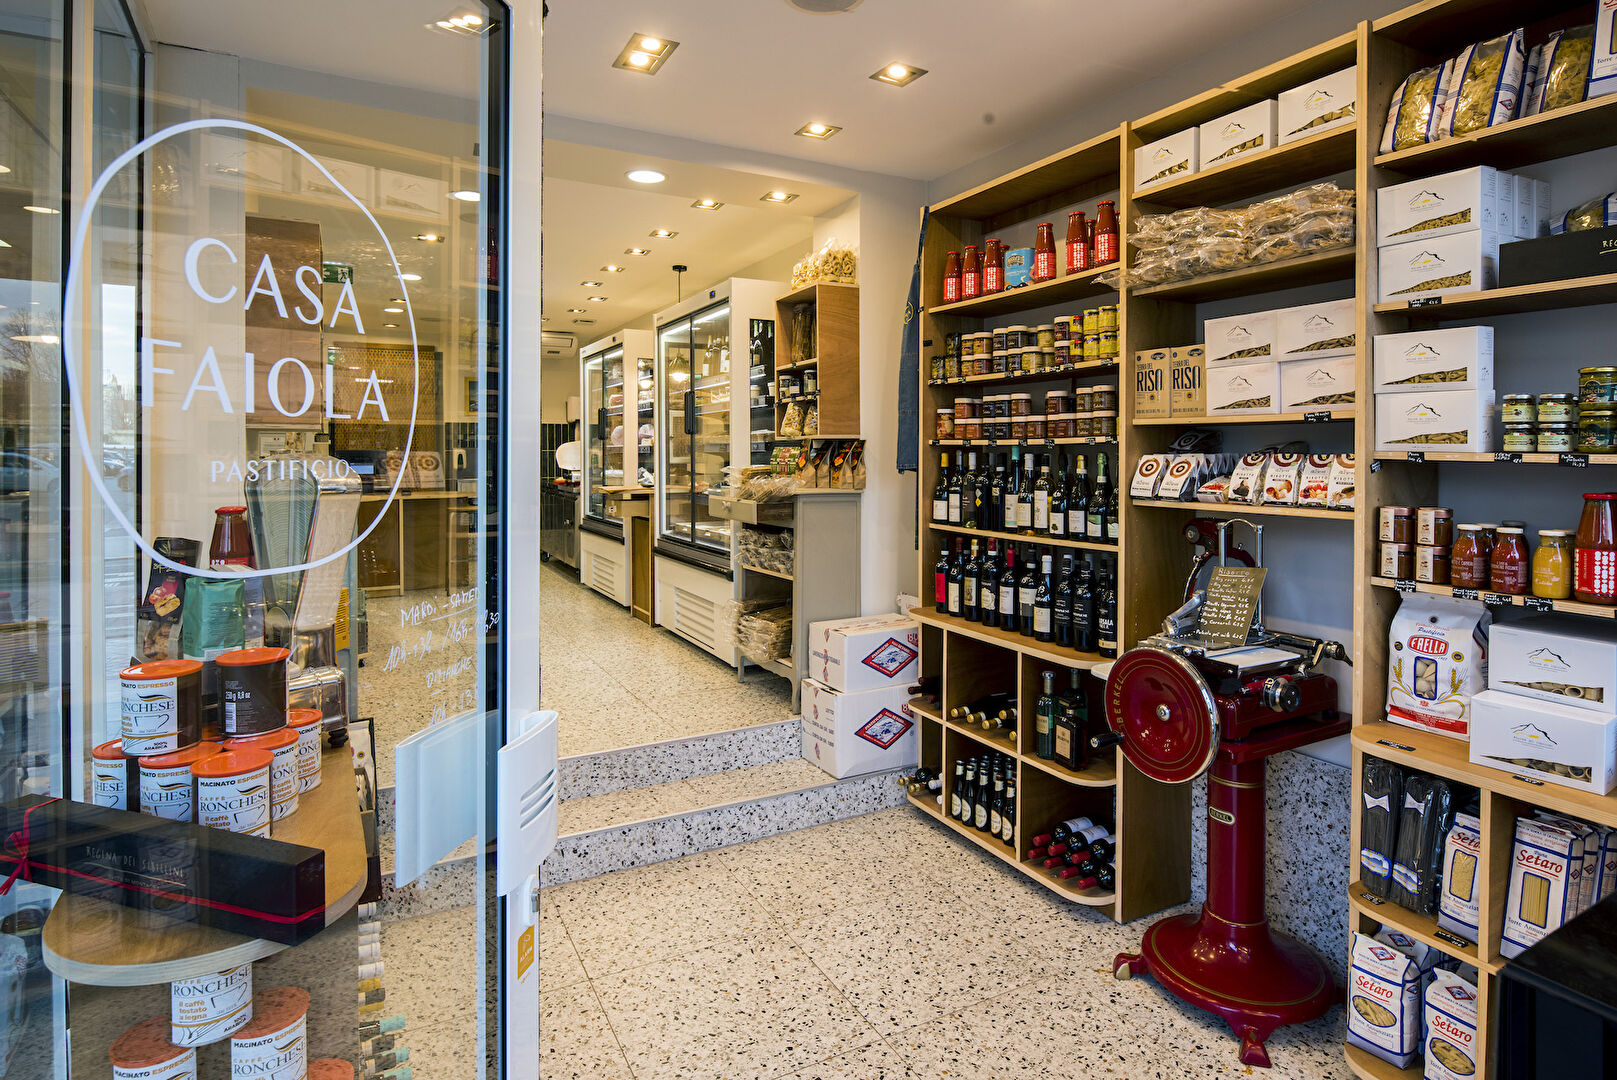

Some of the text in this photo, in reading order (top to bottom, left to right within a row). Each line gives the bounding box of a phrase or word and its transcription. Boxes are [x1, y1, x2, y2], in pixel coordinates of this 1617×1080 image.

[185, 237, 365, 334] CASA
[141, 337, 389, 422] FAIOLA
[1137, 369, 1162, 391] RISO
[1173, 366, 1200, 389] RISO
[211, 459, 350, 484] PASTIFICIO
[1411, 637, 1446, 654] FAELLA
[425, 656, 473, 689] DIMANCHE
[137, 681, 175, 689] ESPRESSO
[1113, 677, 1125, 723] BERKEL
[237, 770, 268, 784] ESPRESSO
[1516, 850, 1563, 873] Setaro
[173, 967, 251, 997] RONCHESE
[1355, 975, 1393, 999] Setaro
[184, 1000, 205, 1008] caffè
[1432, 1015, 1472, 1043] Setaro
[234, 1038, 273, 1048] MACINATO
[114, 1052, 194, 1079] MACINATO ESPRESSO
